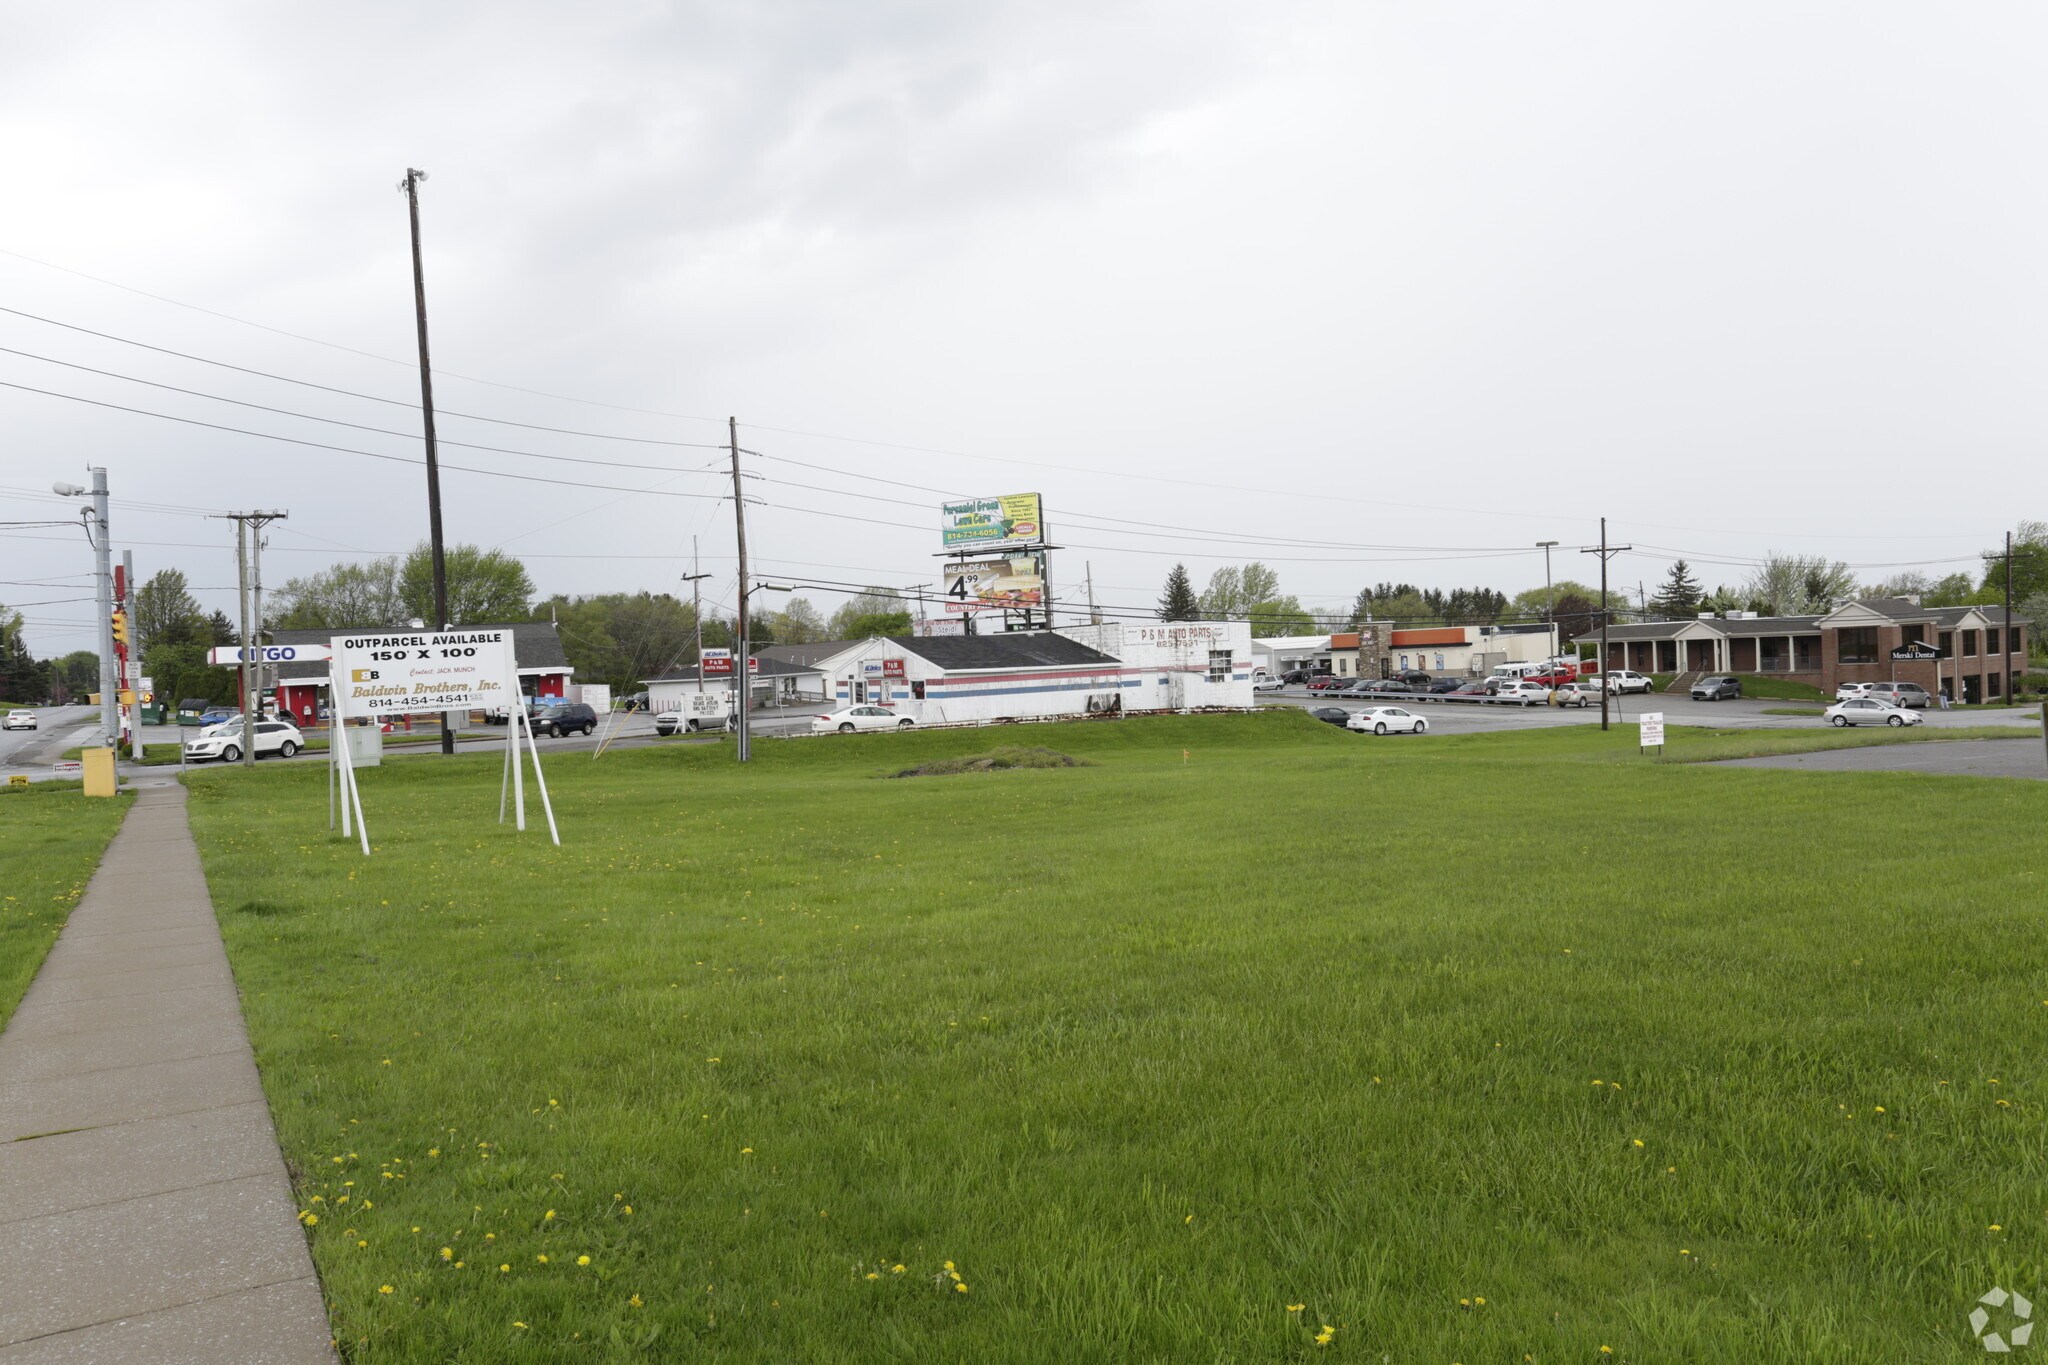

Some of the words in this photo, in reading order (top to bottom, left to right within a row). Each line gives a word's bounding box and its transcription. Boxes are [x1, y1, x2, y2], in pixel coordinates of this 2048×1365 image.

[943, 501, 976, 515] Perennial
[977, 500, 999, 511] Green
[954, 515, 972, 526] Lawn
[973, 513, 991, 524] Care
[945, 565, 967, 574] MEAL
[969, 563, 990, 572] DEAL
[1142, 630, 1146, 640] P
[1150, 629, 1155, 640] &
[1158, 628, 1165, 639] M
[1168, 628, 1186, 639] AUTO
[1189, 627, 1211, 639] PARTS
[345, 637, 426, 649] OUTPARCEL
[432, 633, 501, 645] AVAILABLE
[371, 650, 410, 661] 150'
[417, 650, 431, 659] X
[441, 647, 478, 658] 100'
[352, 685, 407, 698] Baldwin
[413, 680, 473, 695] Brothers,
[477, 680, 501, 691] Inc.
[369, 694, 469, 708] 814-454-4541
[387, 702, 471, 712] www.BaldwinBros.com
